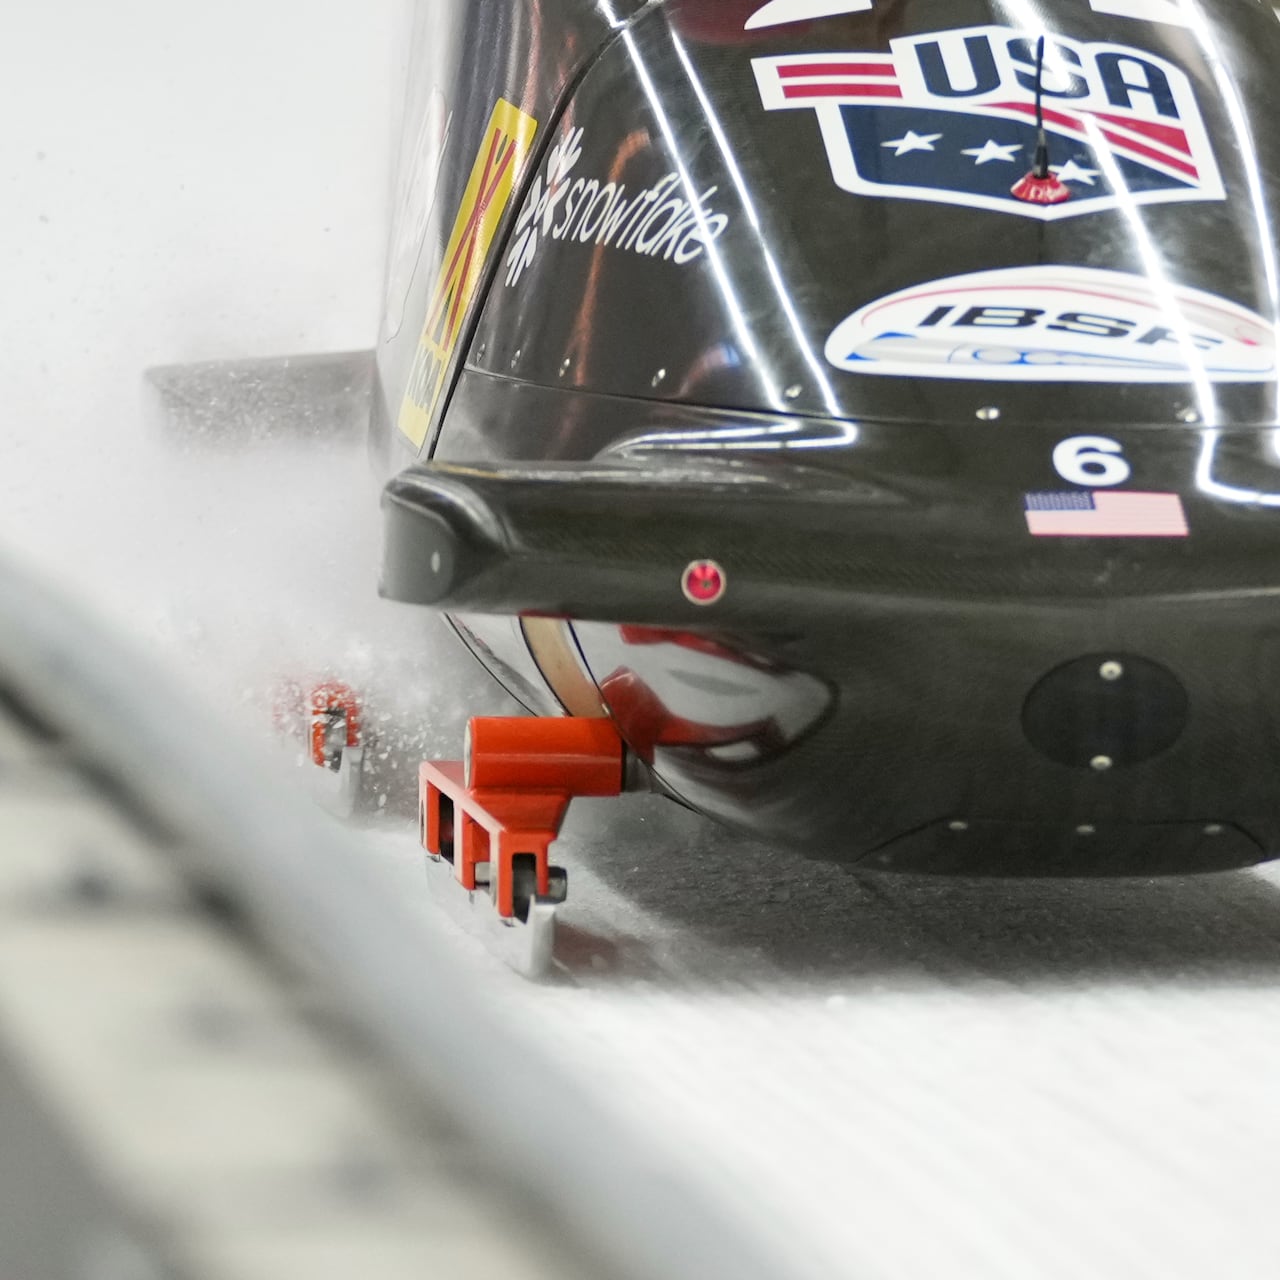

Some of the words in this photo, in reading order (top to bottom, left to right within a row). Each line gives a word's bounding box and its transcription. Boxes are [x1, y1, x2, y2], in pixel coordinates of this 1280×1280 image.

[914, 33, 1180, 120] USA
[553, 172, 728, 264] snowflake
[917, 306, 1223, 350] IBSF
[1052, 435, 1131, 486] 6
